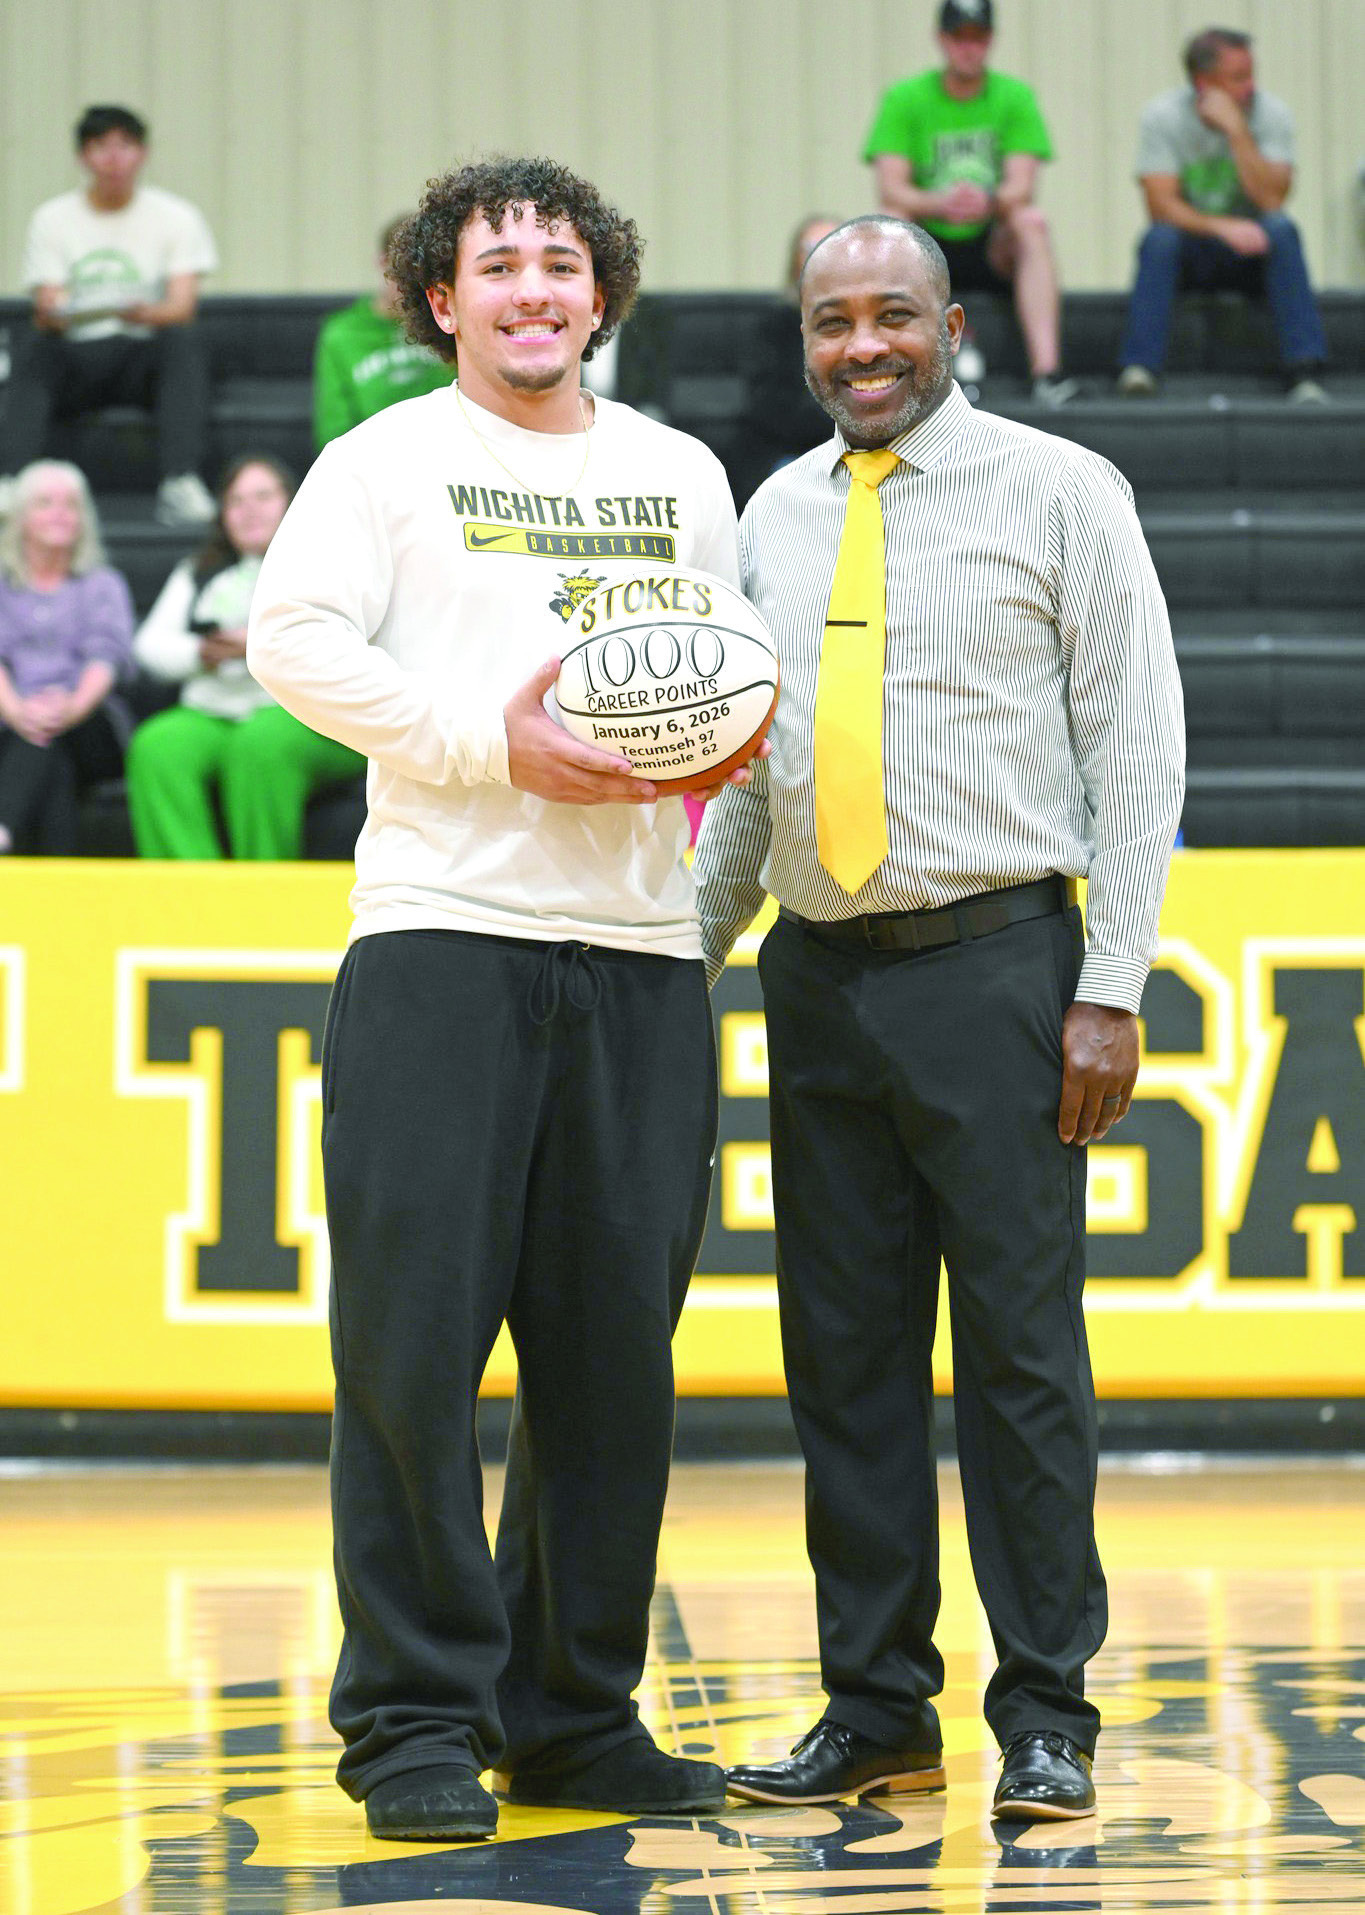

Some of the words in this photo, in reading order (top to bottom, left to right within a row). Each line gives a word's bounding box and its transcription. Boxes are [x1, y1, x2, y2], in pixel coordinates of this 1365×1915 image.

[447, 484, 586, 527] WICHITA
[595, 496, 679, 530] STATE
[530, 535, 672, 557] BASKETBALL
[580, 576, 713, 634] STOKES
[577, 627, 725, 698] 1000
[587, 690, 650, 713] CAREER
[655, 677, 719, 705] POINTS
[592, 722, 661, 741] January
[666, 718, 685, 734] 6,
[688, 701, 731, 728] 2026
[619, 737, 696, 757] Tecumseh
[698, 729, 715, 744] 97
[701, 743, 719, 757] 62
